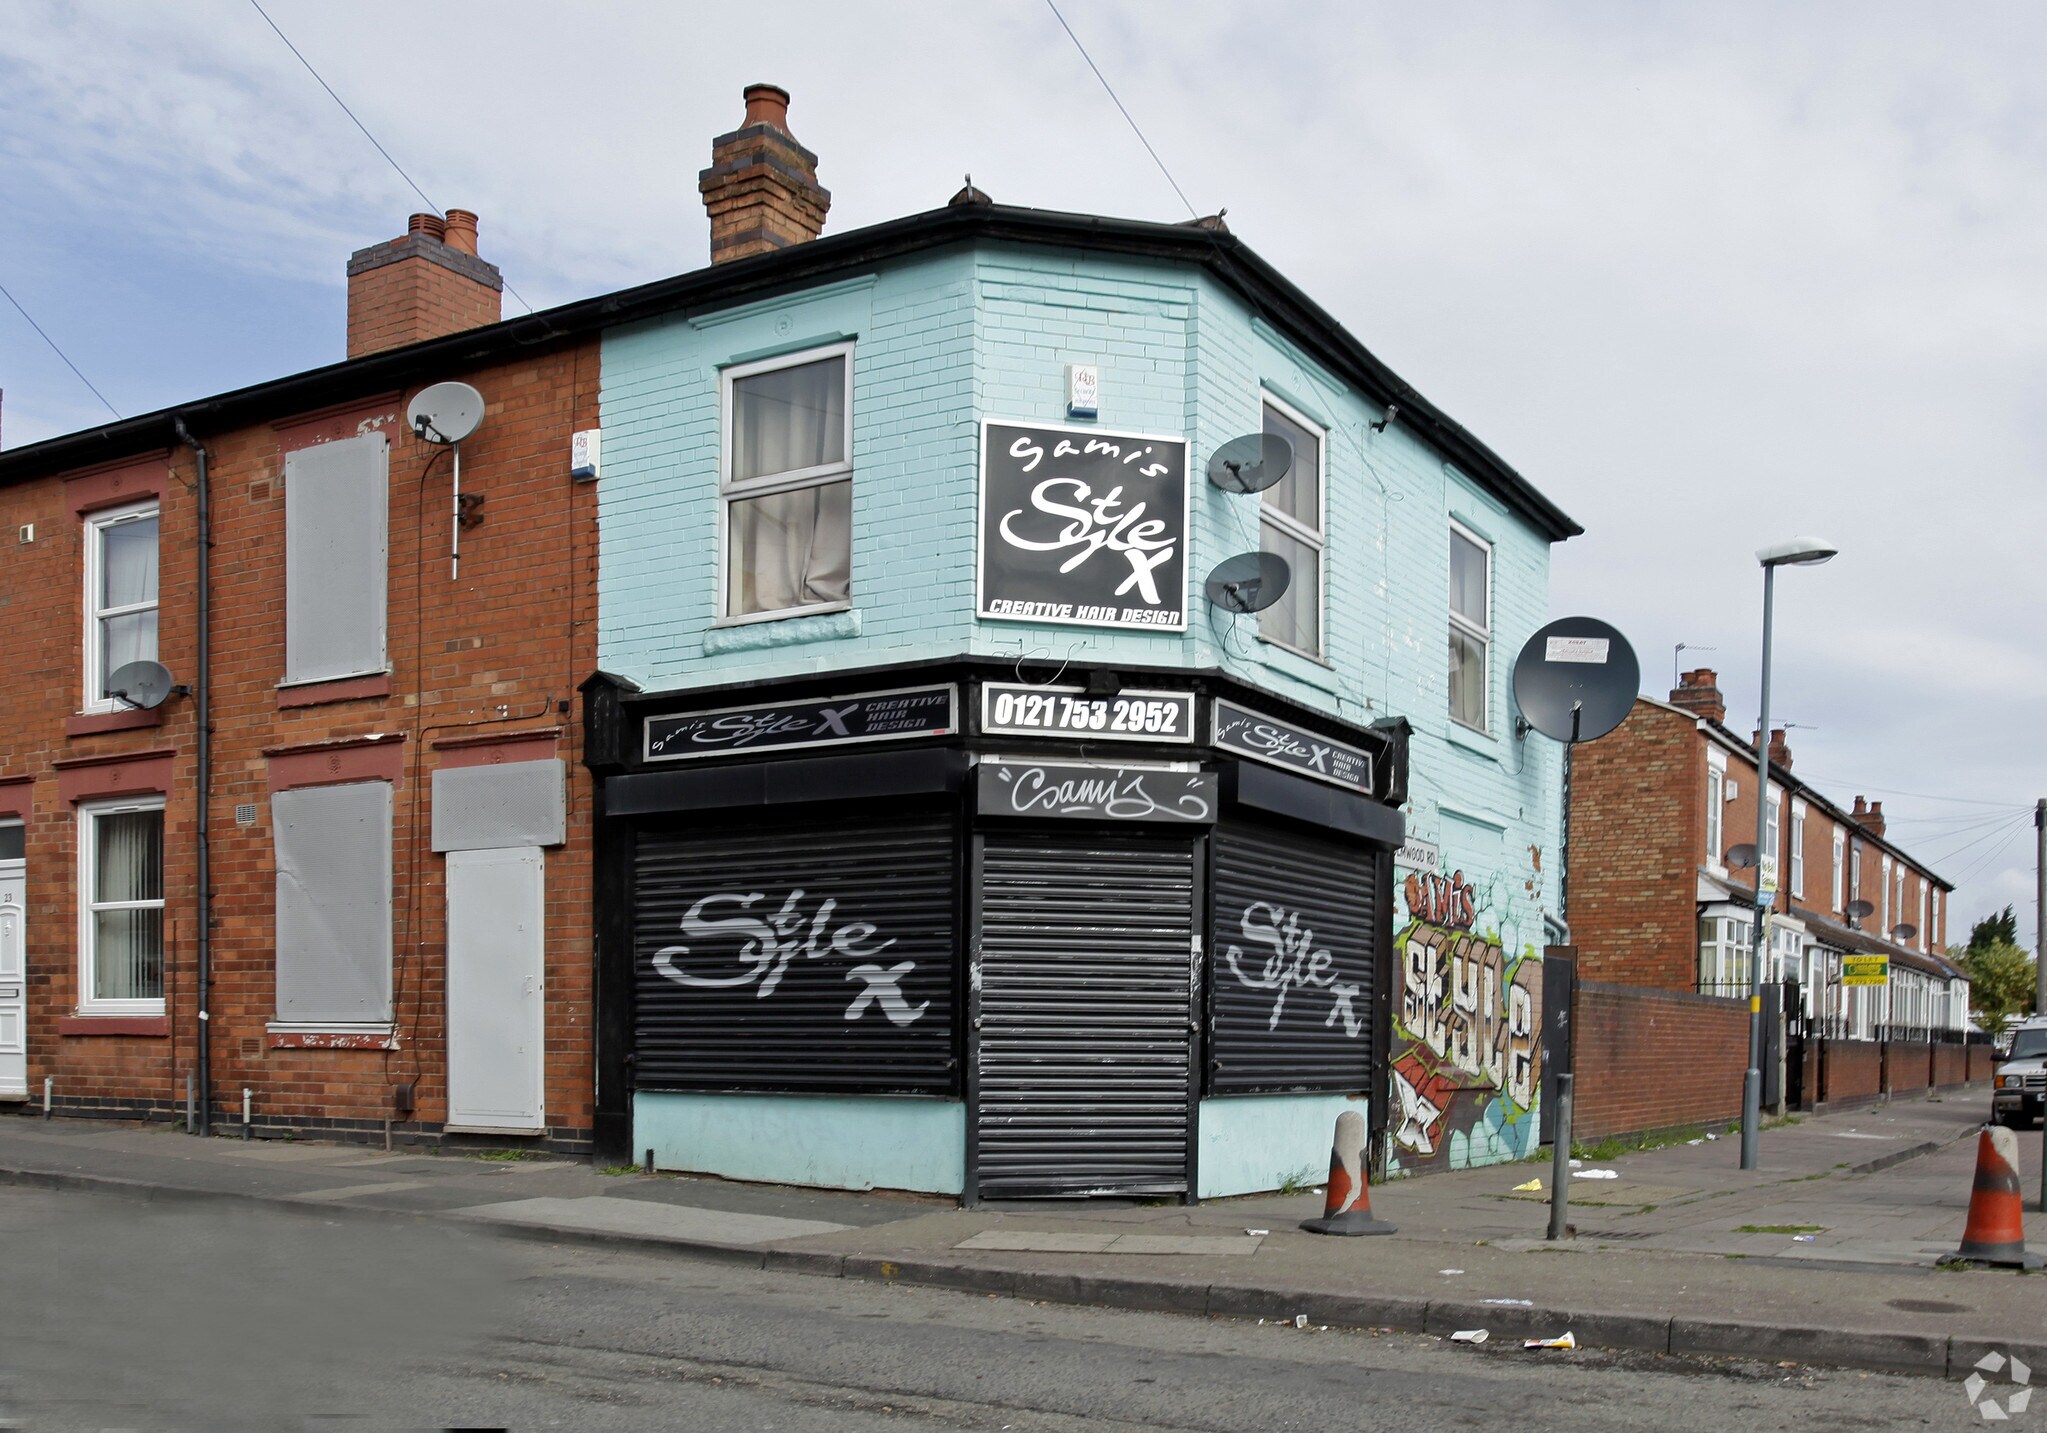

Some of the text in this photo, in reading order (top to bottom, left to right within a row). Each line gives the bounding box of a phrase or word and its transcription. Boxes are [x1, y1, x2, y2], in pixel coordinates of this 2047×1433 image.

[1000, 478, 1177, 574] Style
[1114, 547, 1174, 605] X
[989, 599, 1180, 625] CREATIVE HAIR DESIGN
[865, 695, 948, 711] CREATIVE
[866, 710, 908, 721] HAIR
[994, 693, 1180, 733] 0121 753 2952
[691, 713, 816, 747] Style
[812, 703, 859, 735] X
[865, 718, 927, 732] DESIGN
[1241, 724, 1310, 757] Style
[1308, 744, 1331, 773] X
[1333, 759, 1351, 771] HAIR
[1332, 768, 1360, 783] DESIGN
[1426, 850, 1436, 865] RD
[652, 888, 897, 1000] Style
[1225, 901, 1339, 1032] Style
